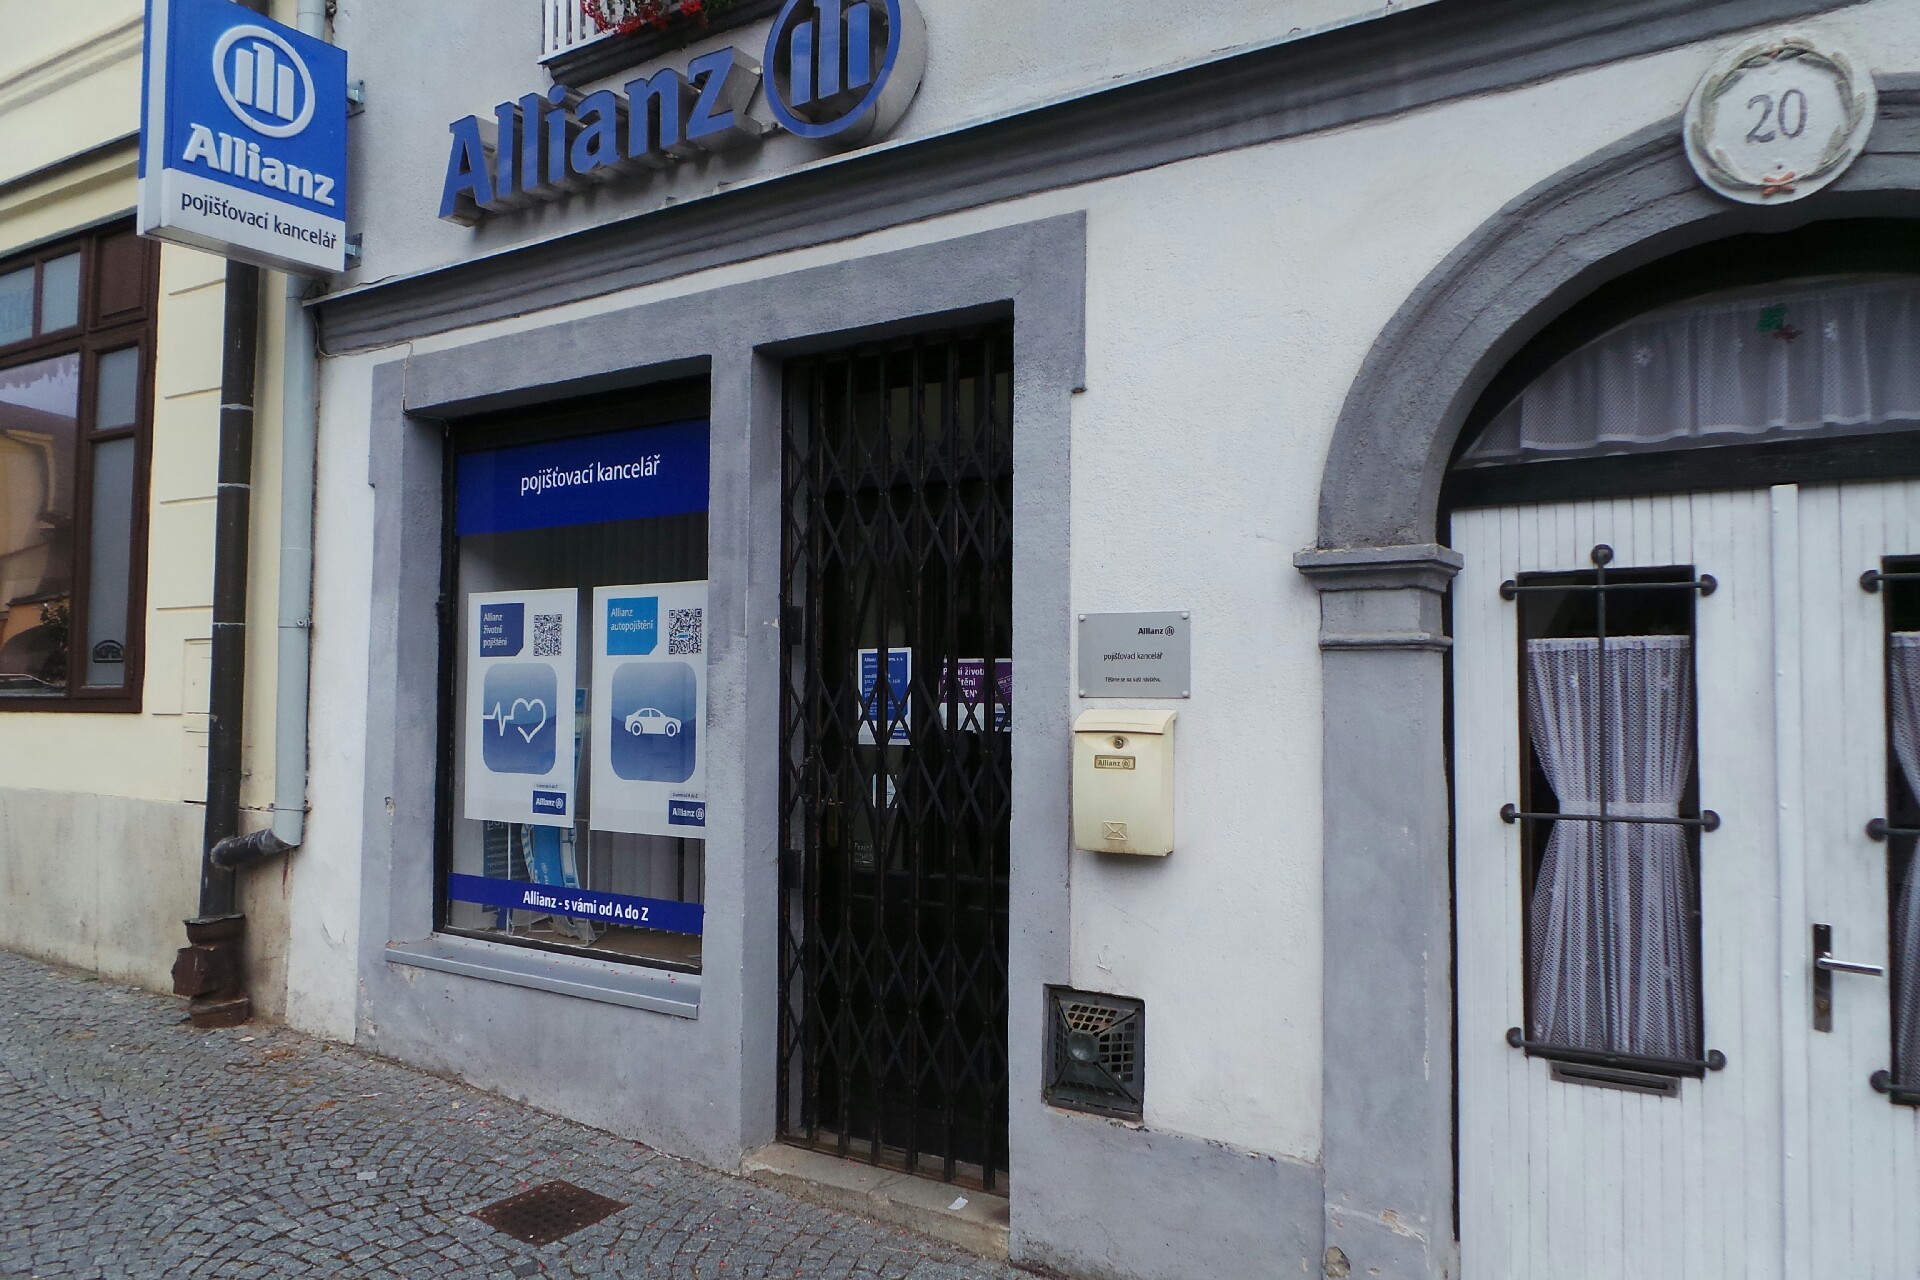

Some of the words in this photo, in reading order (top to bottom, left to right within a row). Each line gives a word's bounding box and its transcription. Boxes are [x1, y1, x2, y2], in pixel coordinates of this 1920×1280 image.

[1747, 89, 1808, 143] 20
[438, 46, 735, 220] Allianz
[183, 122, 335, 207] Allianz
[181, 192, 268, 230] pojišťovací
[274, 215, 337, 249] kancelář
[521, 463, 594, 496] pojišťovací
[597, 454, 661, 482] kancelář
[483, 612, 503, 622] Allianz
[610, 607, 634, 617] Allianz
[483, 625, 503, 634] životní
[610, 619, 654, 633] autopojištění
[1138, 627, 1164, 635] Allianz
[483, 637, 508, 649] pojištění
[1137, 651, 1163, 660] kancelář
[535, 797, 556, 807] Allianz
[672, 807, 695, 818] Allianz
[523, 890, 557, 909] Allianz
[564, 899, 570, 911] s
[571, 898, 597, 914] vámi
[598, 902, 613, 916] od
[614, 904, 624, 918] A
[624, 904, 639, 920] do
[641, 907, 649, 921] Z
